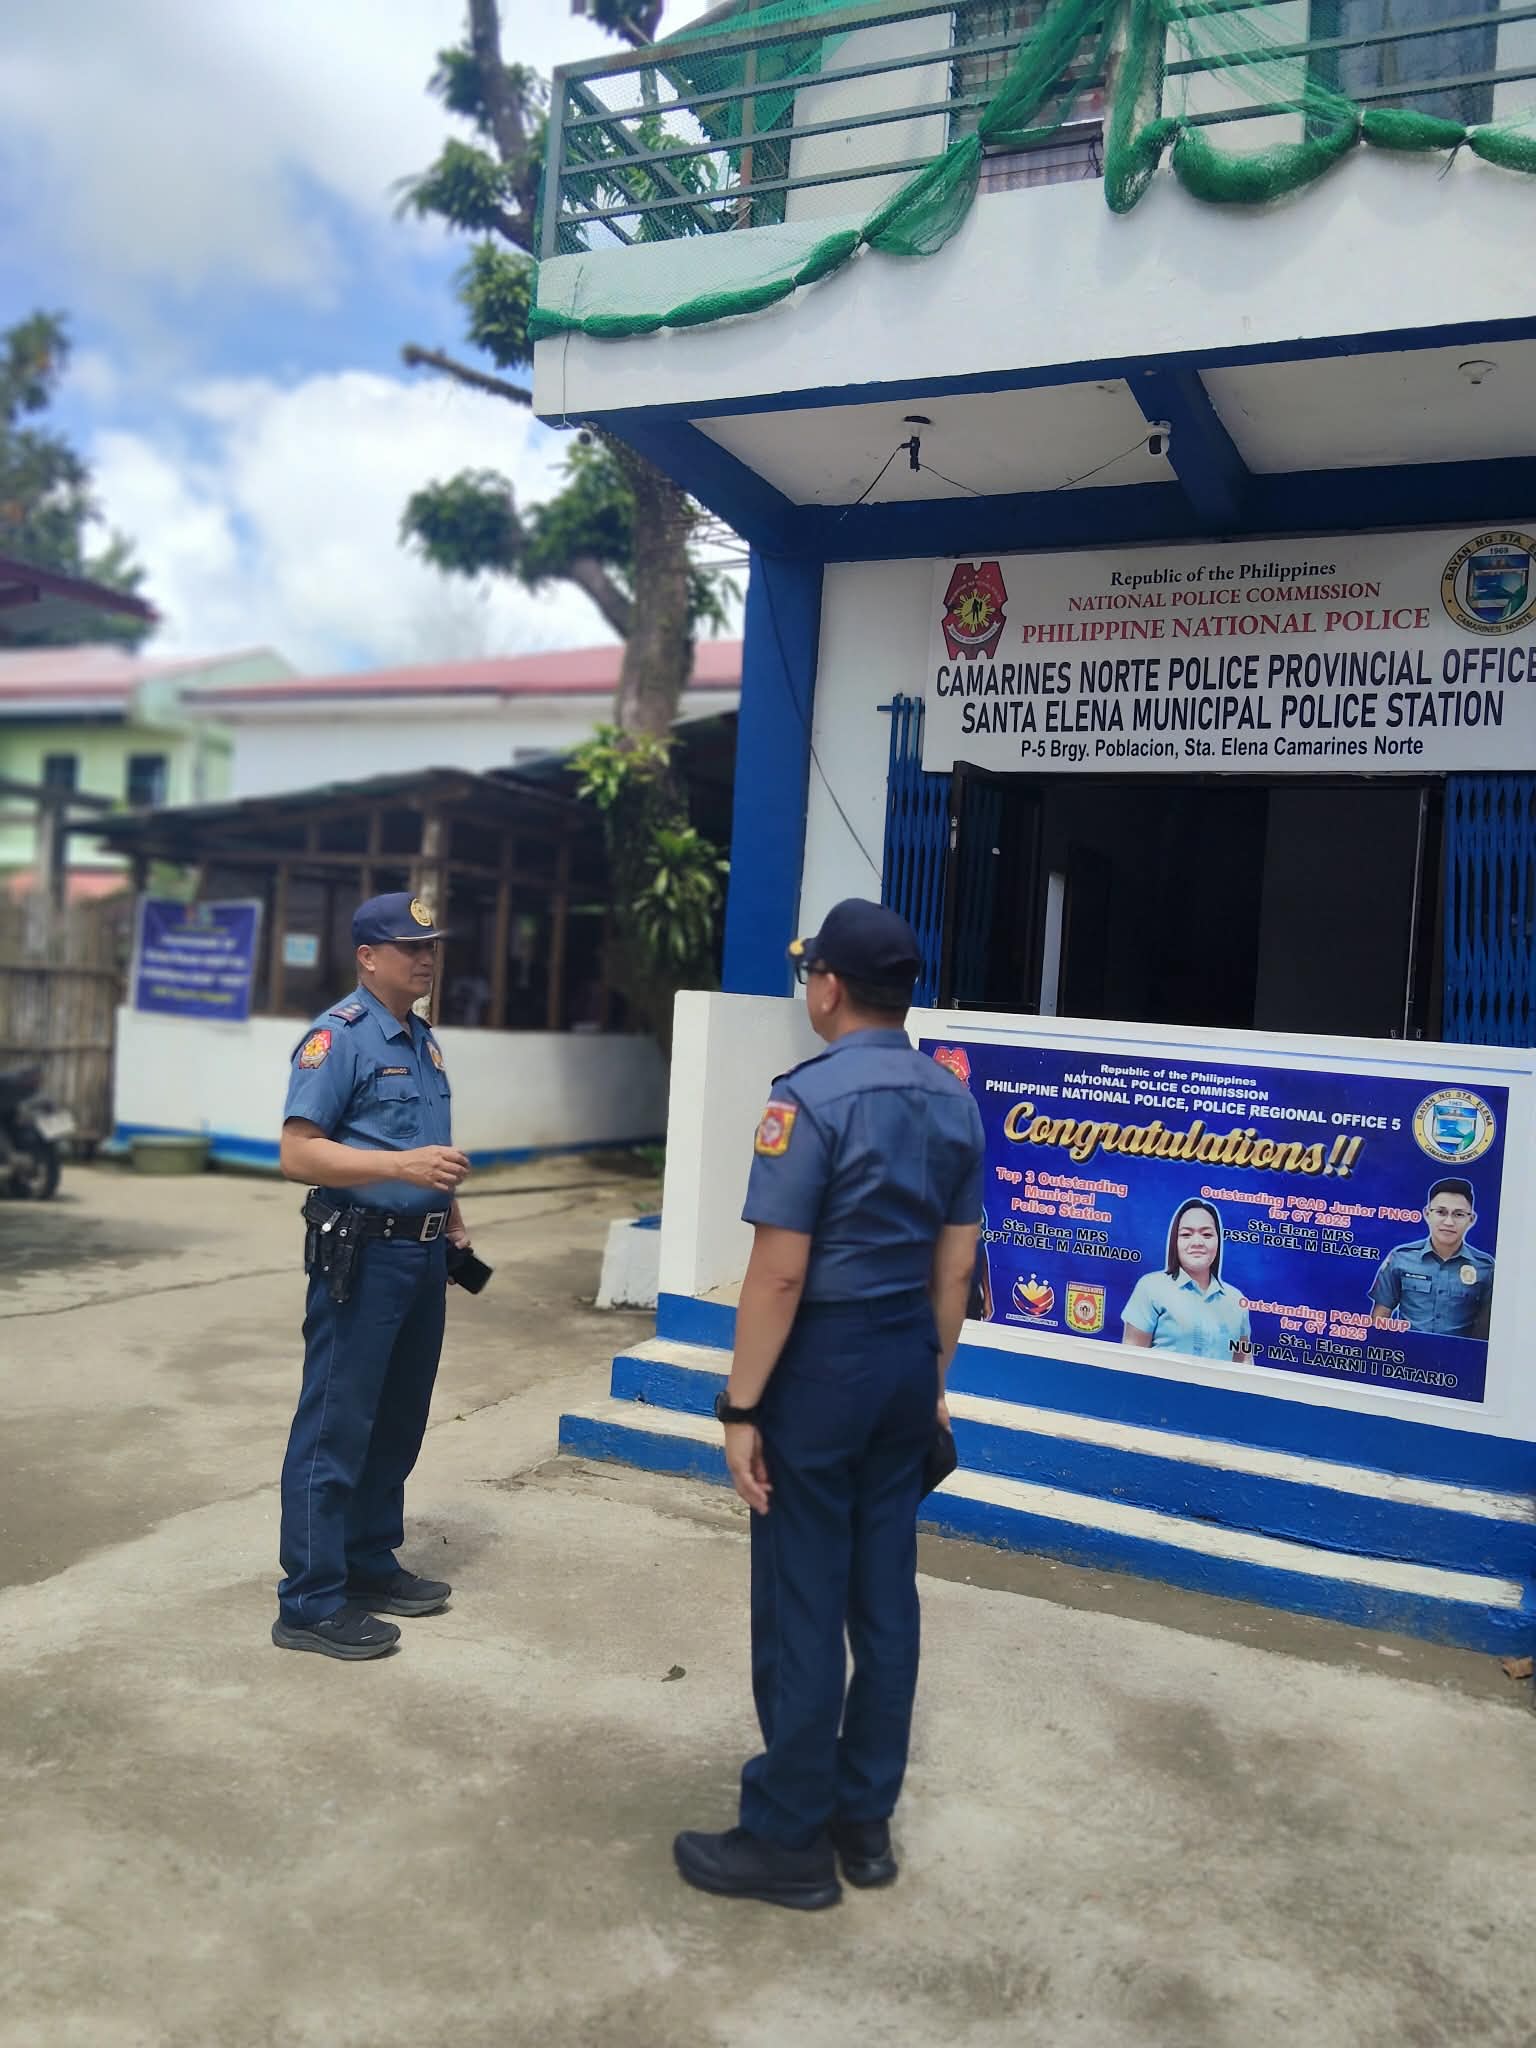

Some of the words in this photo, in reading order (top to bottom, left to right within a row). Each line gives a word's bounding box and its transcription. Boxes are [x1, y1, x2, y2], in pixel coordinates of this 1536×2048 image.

[1444, 546, 1472, 581] BAYAN
[1475, 535, 1494, 548] NG
[1111, 568, 1182, 590] Republic
[1187, 566, 1207, 583] of
[1208, 565, 1235, 582] the
[1239, 561, 1337, 583] Philippines
[1068, 592, 1166, 612] NATIONAL
[1171, 588, 1241, 607] POLICE
[1246, 582, 1381, 603] COMMISSION
[1022, 619, 1165, 644] PHILIPPINE
[1172, 612, 1317, 639] NATIONAL
[1324, 607, 1431, 632] POLICE
[936, 661, 1072, 697] CAMARINES
[1079, 658, 1161, 693] NORTE
[1168, 655, 1260, 691] POLICE
[1267, 649, 1433, 689] PROVINCIAL
[961, 701, 1037, 734] SANTA
[1045, 699, 1124, 733] ELENA
[1132, 695, 1272, 731] MUNICIPAL
[1280, 692, 1378, 729] POLICE
[1386, 690, 1504, 727] STATION
[1021, 739, 1046, 758] P-5
[1050, 739, 1090, 762] Brgy.
[1095, 738, 1179, 759] Poblacion,
[1184, 737, 1216, 756] Sta.
[1221, 736, 1268, 756] Elena
[1273, 736, 1368, 757] Camarines
[1374, 735, 1424, 755] Norte
[1064, 1073, 1128, 1088] NATIONAL
[1131, 1079, 1178, 1093] POLICE
[1181, 1084, 1269, 1101] COMMISSION
[1100, 1064, 1150, 1077] Republic
[1153, 1067, 1166, 1078] of
[1168, 1069, 1188, 1080] the
[1191, 1071, 1257, 1086] Philippines
[985, 1079, 1059, 1098] PHILIPPINE
[1062, 1086, 1131, 1105] NATIONAL
[1134, 1093, 1190, 1112] POLICE,
[1193, 1099, 1246, 1116] POLICE
[1250, 1104, 1327, 1123] REGIONAL
[1331, 1112, 1388, 1129] OFFICE
[1391, 1118, 1401, 1131] 5
[1003, 1100, 1366, 1179] Congratulations!!
[996, 1167, 1022, 1184] Top
[1025, 1170, 1035, 1184] 3
[1038, 1171, 1129, 1198] Outstanding
[1024, 1185, 1096, 1206] Municipal
[1011, 1198, 1056, 1216] Police
[1059, 1203, 1112, 1223] Station
[1200, 1186, 1285, 1208] Outstanding
[1287, 1194, 1327, 1212] PCAD
[1329, 1200, 1376, 1217] Junior
[1379, 1206, 1423, 1223] PNCO
[1268, 1207, 1289, 1220] for
[1291, 1210, 1311, 1223] CY
[1314, 1213, 1351, 1229] 2025
[1003, 1217, 1030, 1233] Sta.
[1034, 1222, 1073, 1240] Elena
[1077, 1229, 1108, 1243] MPS
[1223, 1228, 1259, 1244] PSSG
[1263, 1234, 1301, 1250] ROEL
[1304, 1238, 1318, 1252] M
[1322, 1242, 1381, 1260] BLACER
[1248, 1219, 1275, 1234] Sta.
[1279, 1223, 1318, 1239] Elena
[1322, 1227, 1353, 1243] MPS
[1013, 1233, 1054, 1251] NOEL
[1056, 1239, 1070, 1253] M
[1071, 1242, 1142, 1263] ARIMADO
[1238, 1296, 1327, 1322] Outstanding
[1330, 1308, 1373, 1327] PCAD
[1374, 1317, 1411, 1333] NUP
[1279, 1316, 1303, 1331] for
[1304, 1320, 1326, 1335] CY
[1329, 1324, 1368, 1341] 2025
[1278, 1332, 1311, 1350] Sta.
[1315, 1337, 1363, 1358] Elena
[1367, 1345, 1405, 1364] MPS
[1229, 1339, 1264, 1356] NUP
[1268, 1344, 1298, 1362] MA.
[1303, 1352, 1367, 1374] LAARNI
[1370, 1361, 1378, 1376] I
[1381, 1364, 1458, 1389] DATARIO
